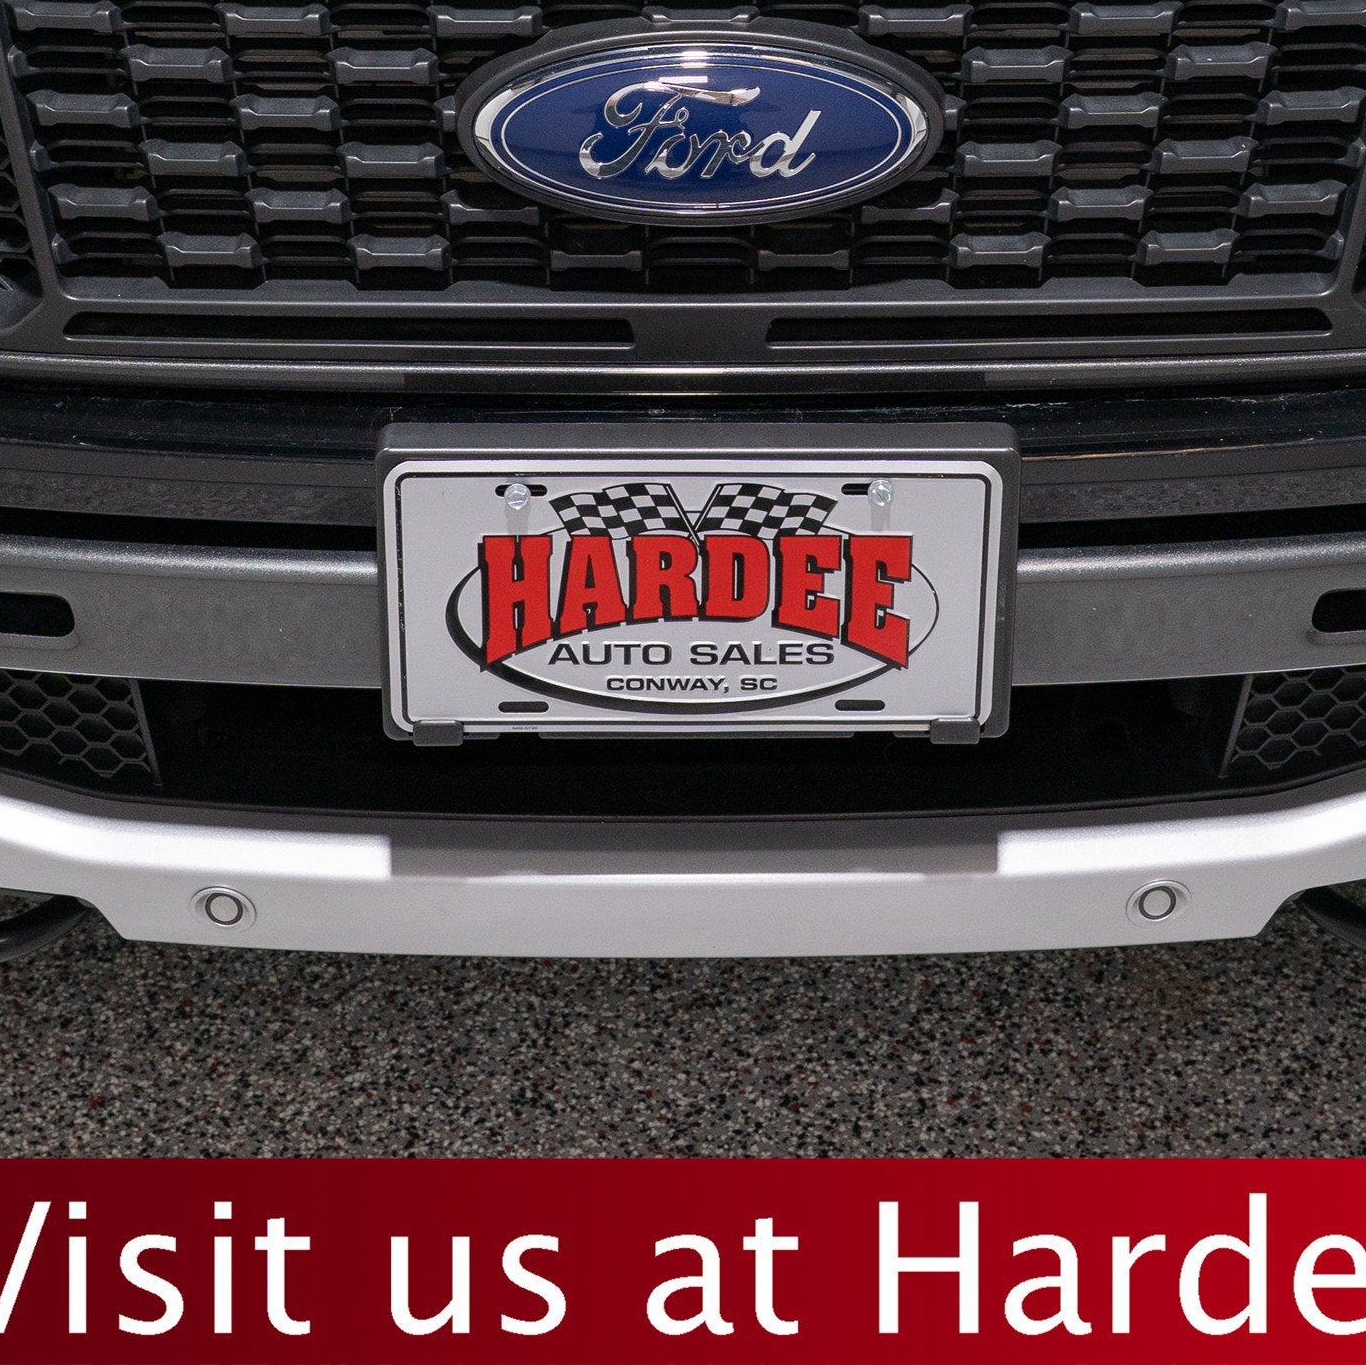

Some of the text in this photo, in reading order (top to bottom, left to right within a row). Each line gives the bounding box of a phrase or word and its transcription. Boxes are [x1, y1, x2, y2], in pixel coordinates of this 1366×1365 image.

[578, 79, 822, 180] Ford
[478, 534, 913, 671] HARDEE
[547, 642, 835, 666] AUTO SALES
[605, 676, 778, 694] CONWAY, SC
